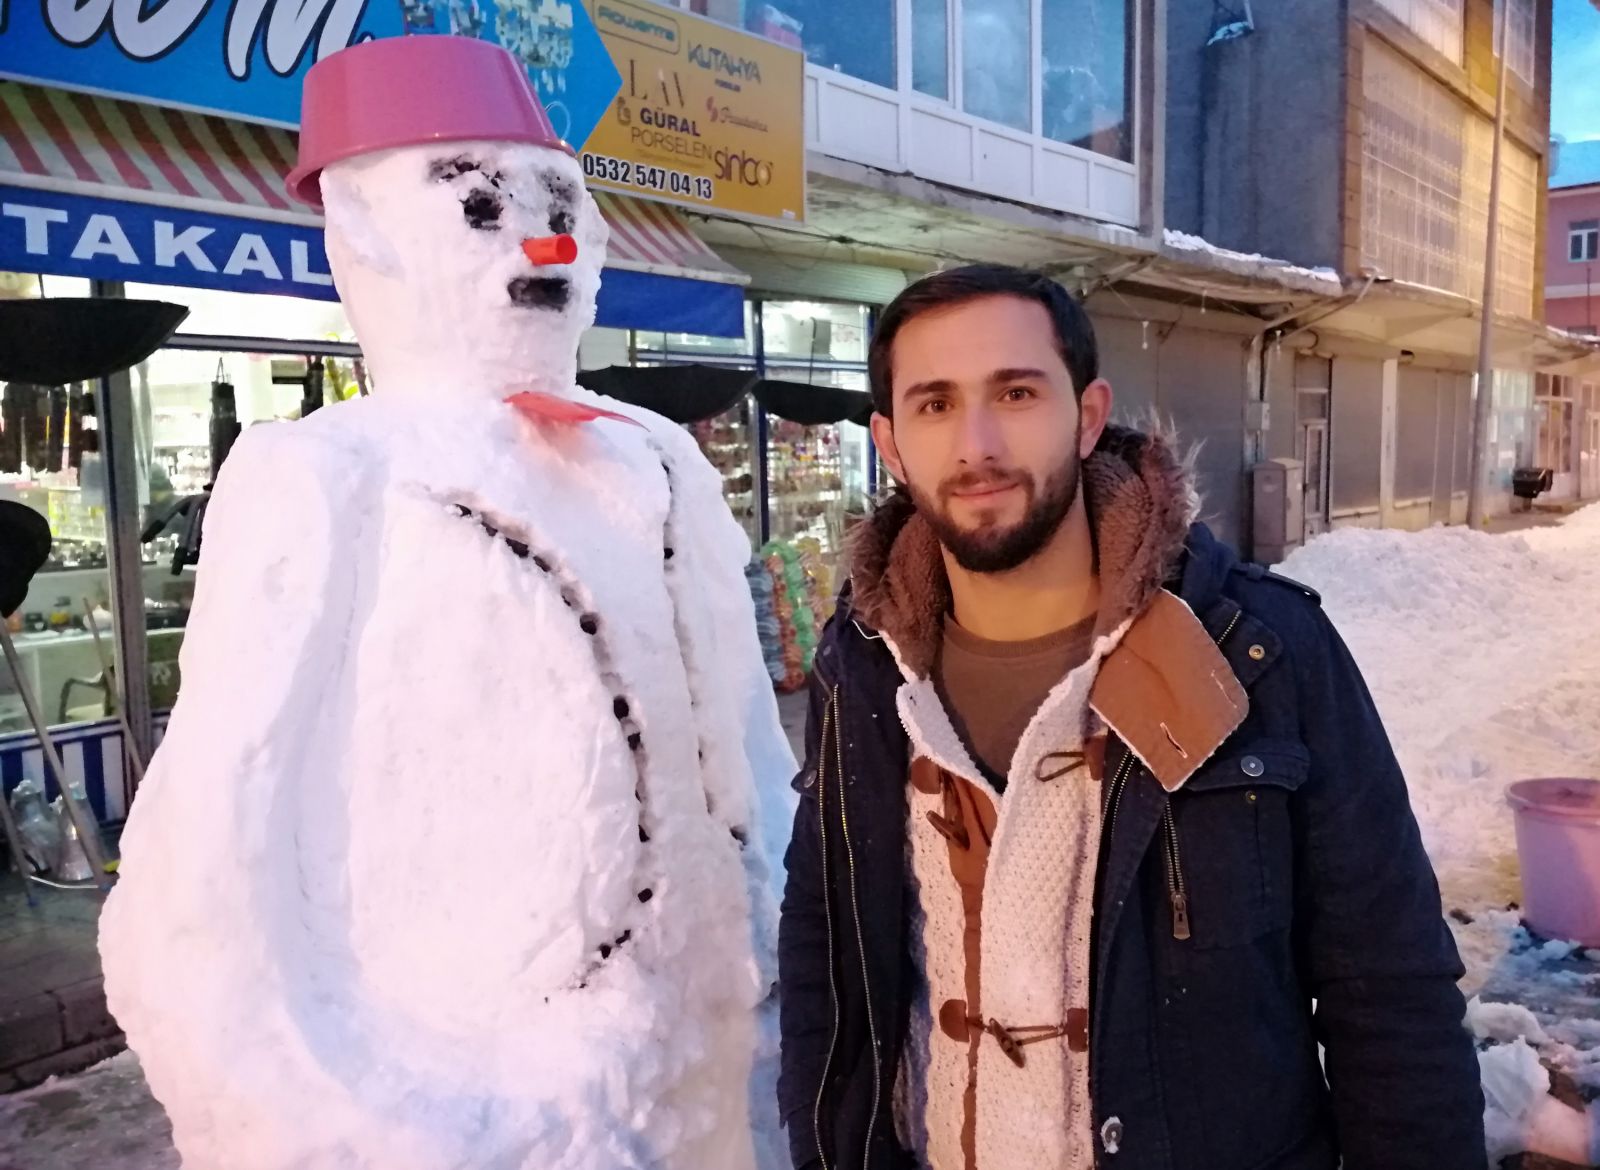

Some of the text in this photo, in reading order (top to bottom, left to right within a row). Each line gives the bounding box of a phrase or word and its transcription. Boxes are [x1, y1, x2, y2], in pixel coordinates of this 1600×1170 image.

[640, 106, 701, 137] GÜRAL
[631, 126, 713, 160] PORSELEN
[583, 154, 630, 183] 0532
[636, 165, 666, 190] 547
[670, 172, 691, 195] 04
[695, 178, 713, 199] 13
